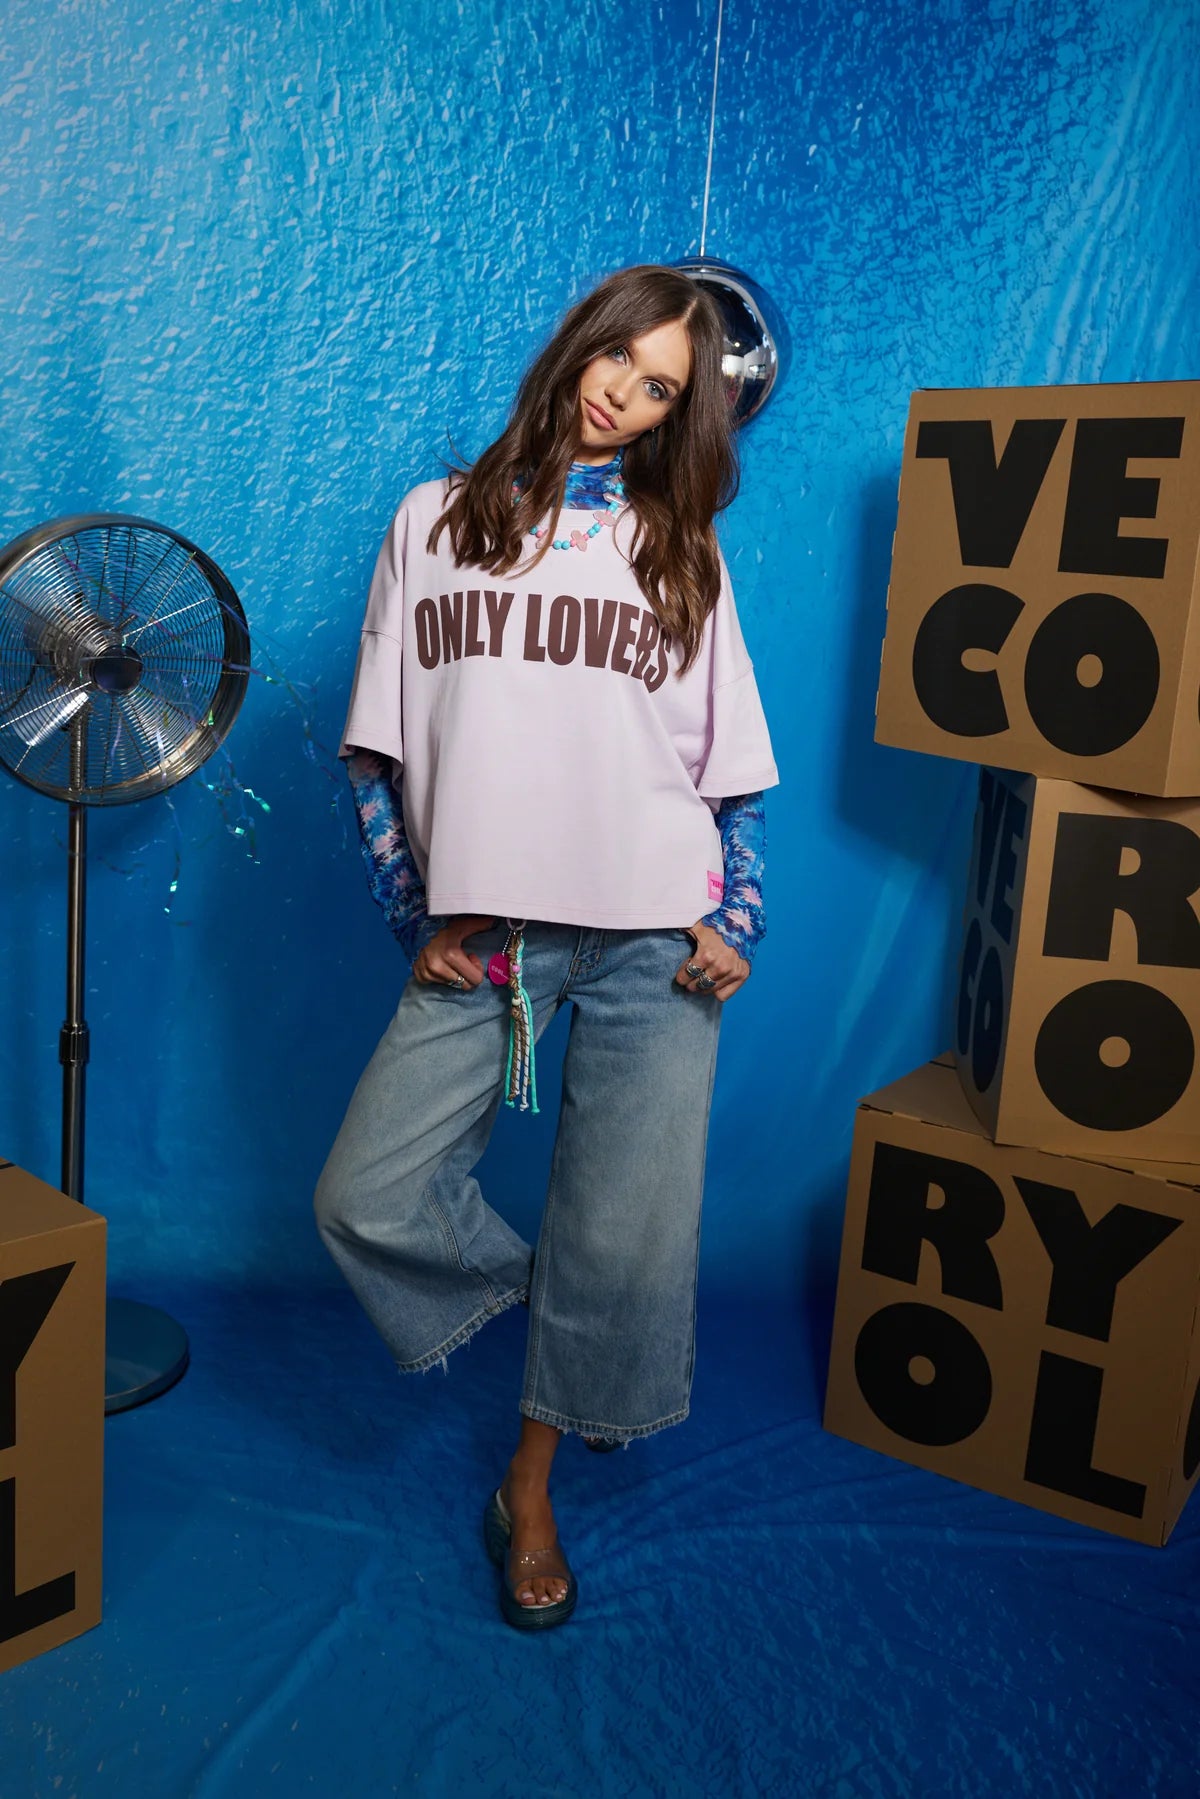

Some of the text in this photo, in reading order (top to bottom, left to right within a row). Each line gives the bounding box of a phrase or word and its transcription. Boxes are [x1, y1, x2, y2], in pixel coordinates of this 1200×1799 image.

[916, 417, 1185, 579] VE
[415, 590, 672, 693] ONLY LOVERS
[912, 584, 1160, 757] CO
[957, 918, 1003, 1093] CO
[861, 1141, 1184, 1343] RY
[854, 1302, 1147, 1519] OL
